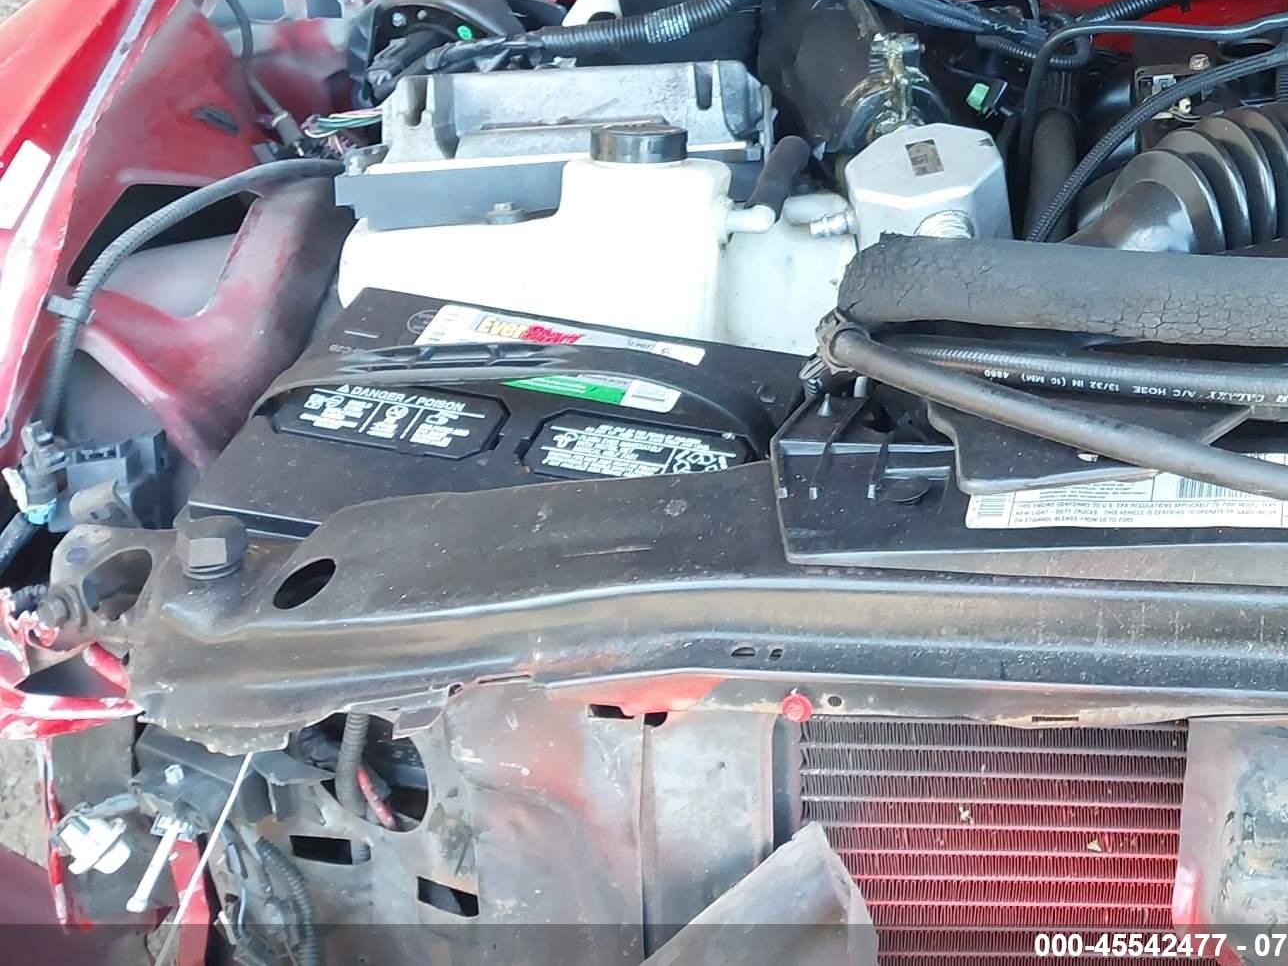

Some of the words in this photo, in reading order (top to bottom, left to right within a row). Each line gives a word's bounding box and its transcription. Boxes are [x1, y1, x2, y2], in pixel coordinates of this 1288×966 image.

[1090, 380, 1120, 392] 13/32
[1132, 385, 1167, 396] HOSE
[351, 386, 408, 403] DANGER
[418, 396, 466, 413] POISON
